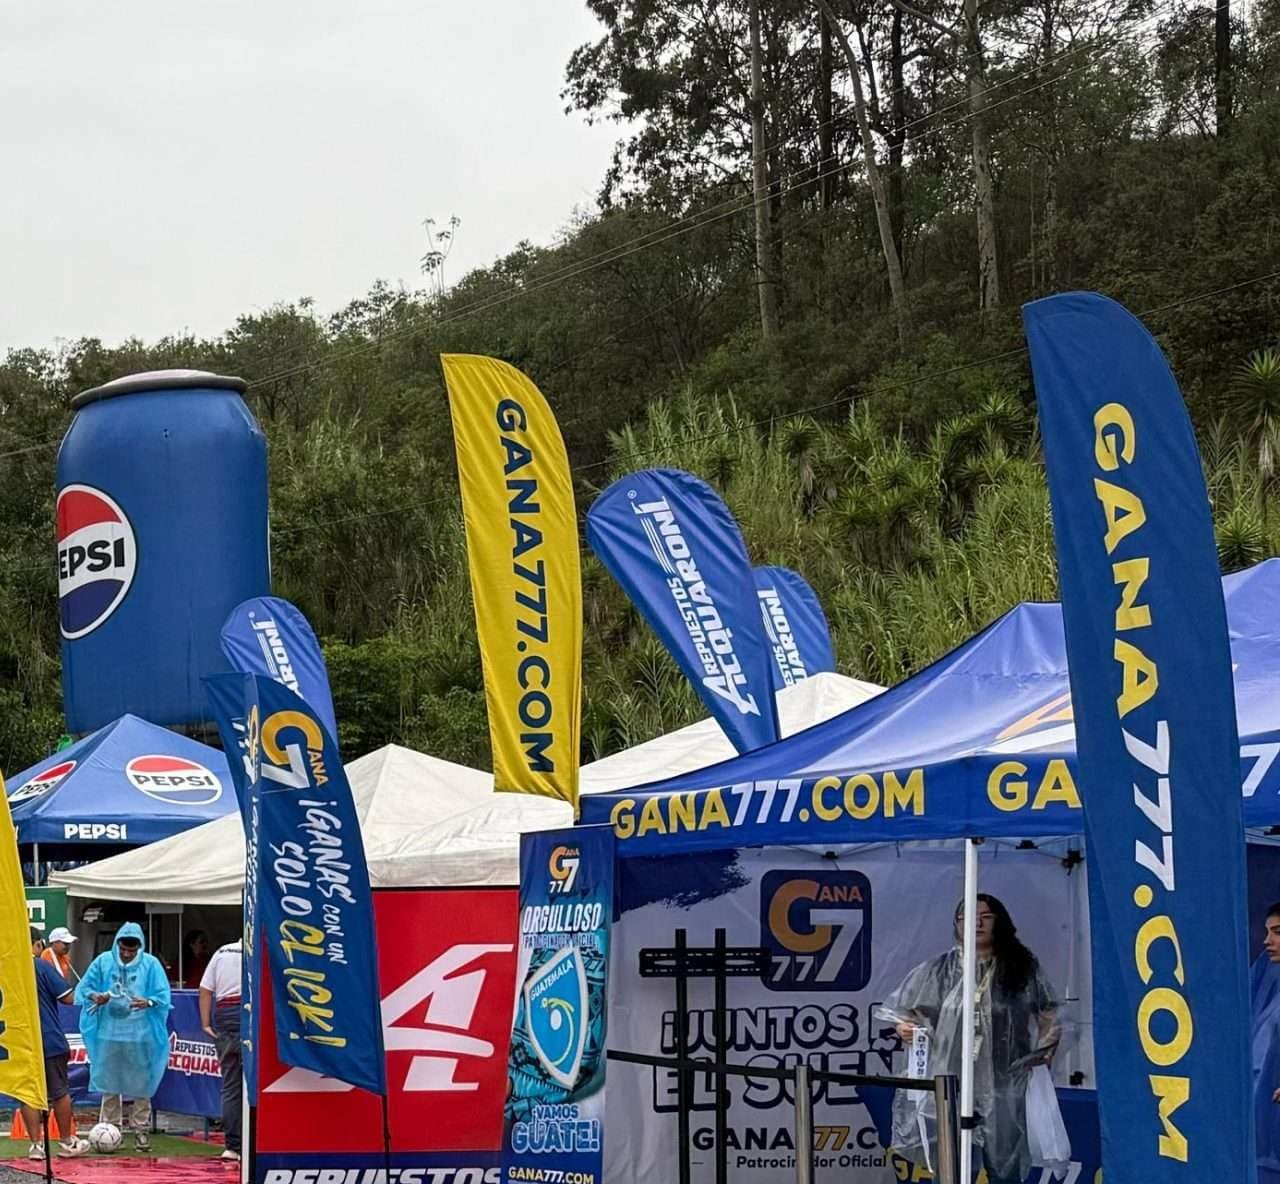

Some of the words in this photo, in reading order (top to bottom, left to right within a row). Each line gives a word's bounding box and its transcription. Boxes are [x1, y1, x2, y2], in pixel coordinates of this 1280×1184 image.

[60, 537, 125, 580] EPSI
[495, 398, 554, 773] GANA777.COM
[666, 577, 722, 676] REPUESTOS
[132, 774, 215, 787] PEPSI
[1093, 402, 1193, 1162] GANA777.COM
[612, 768, 925, 840] GANA777.COM
[63, 823, 128, 840] PEPSI
[274, 841, 312, 916] SOLO
[323, 905, 342, 938] CON
[522, 903, 602, 934] ORGULLOSO
[329, 938, 348, 965] UN
[278, 918, 347, 1049] CLICK!
[530, 958, 575, 996] GUATEMALA
[175, 1041, 217, 1057] REPUESTOS
[512, 1119, 600, 1154] GUATE!
[839, 1154, 887, 1168] Oficial
